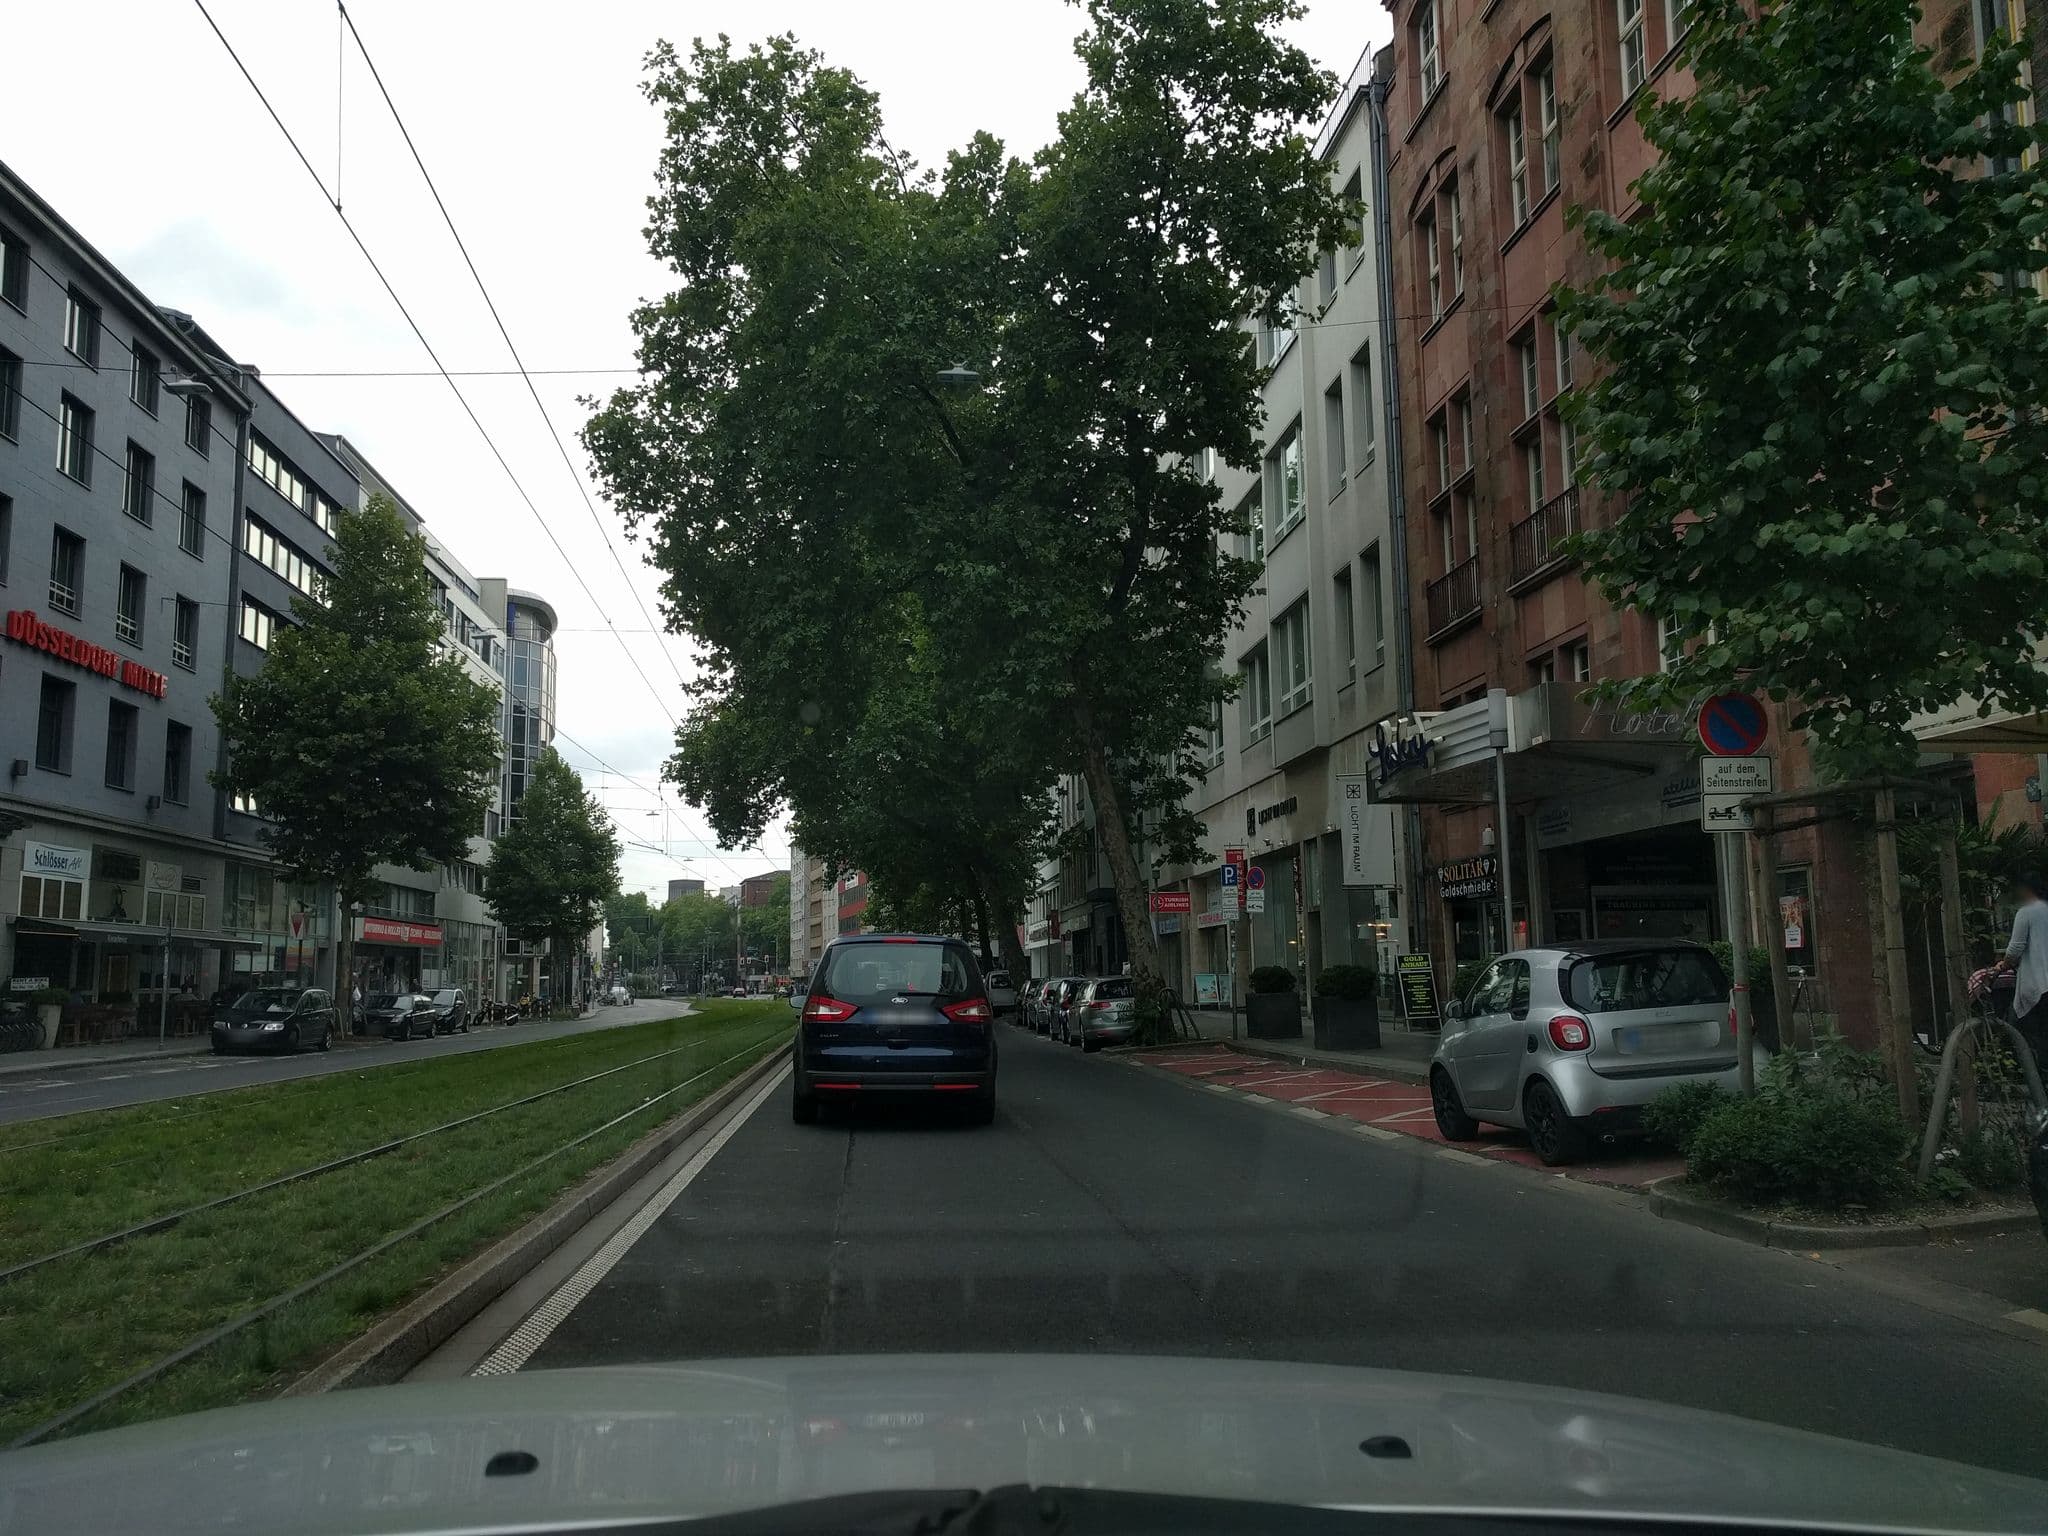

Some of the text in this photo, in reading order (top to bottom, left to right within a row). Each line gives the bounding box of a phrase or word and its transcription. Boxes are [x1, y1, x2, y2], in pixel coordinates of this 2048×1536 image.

[6, 609, 168, 699] DÜSSELDORF MITTE
[1718, 763, 1755, 773] auf dem
[1706, 776, 1768, 787] Seitenstreifen
[1350, 805, 1361, 872] LICHT IM RAUM
[34, 849, 69, 869] Schlösser
[1224, 866, 1234, 884] P
[1443, 858, 1485, 882] SOLITÄR
[1440, 879, 1492, 898] Goldschmiede
